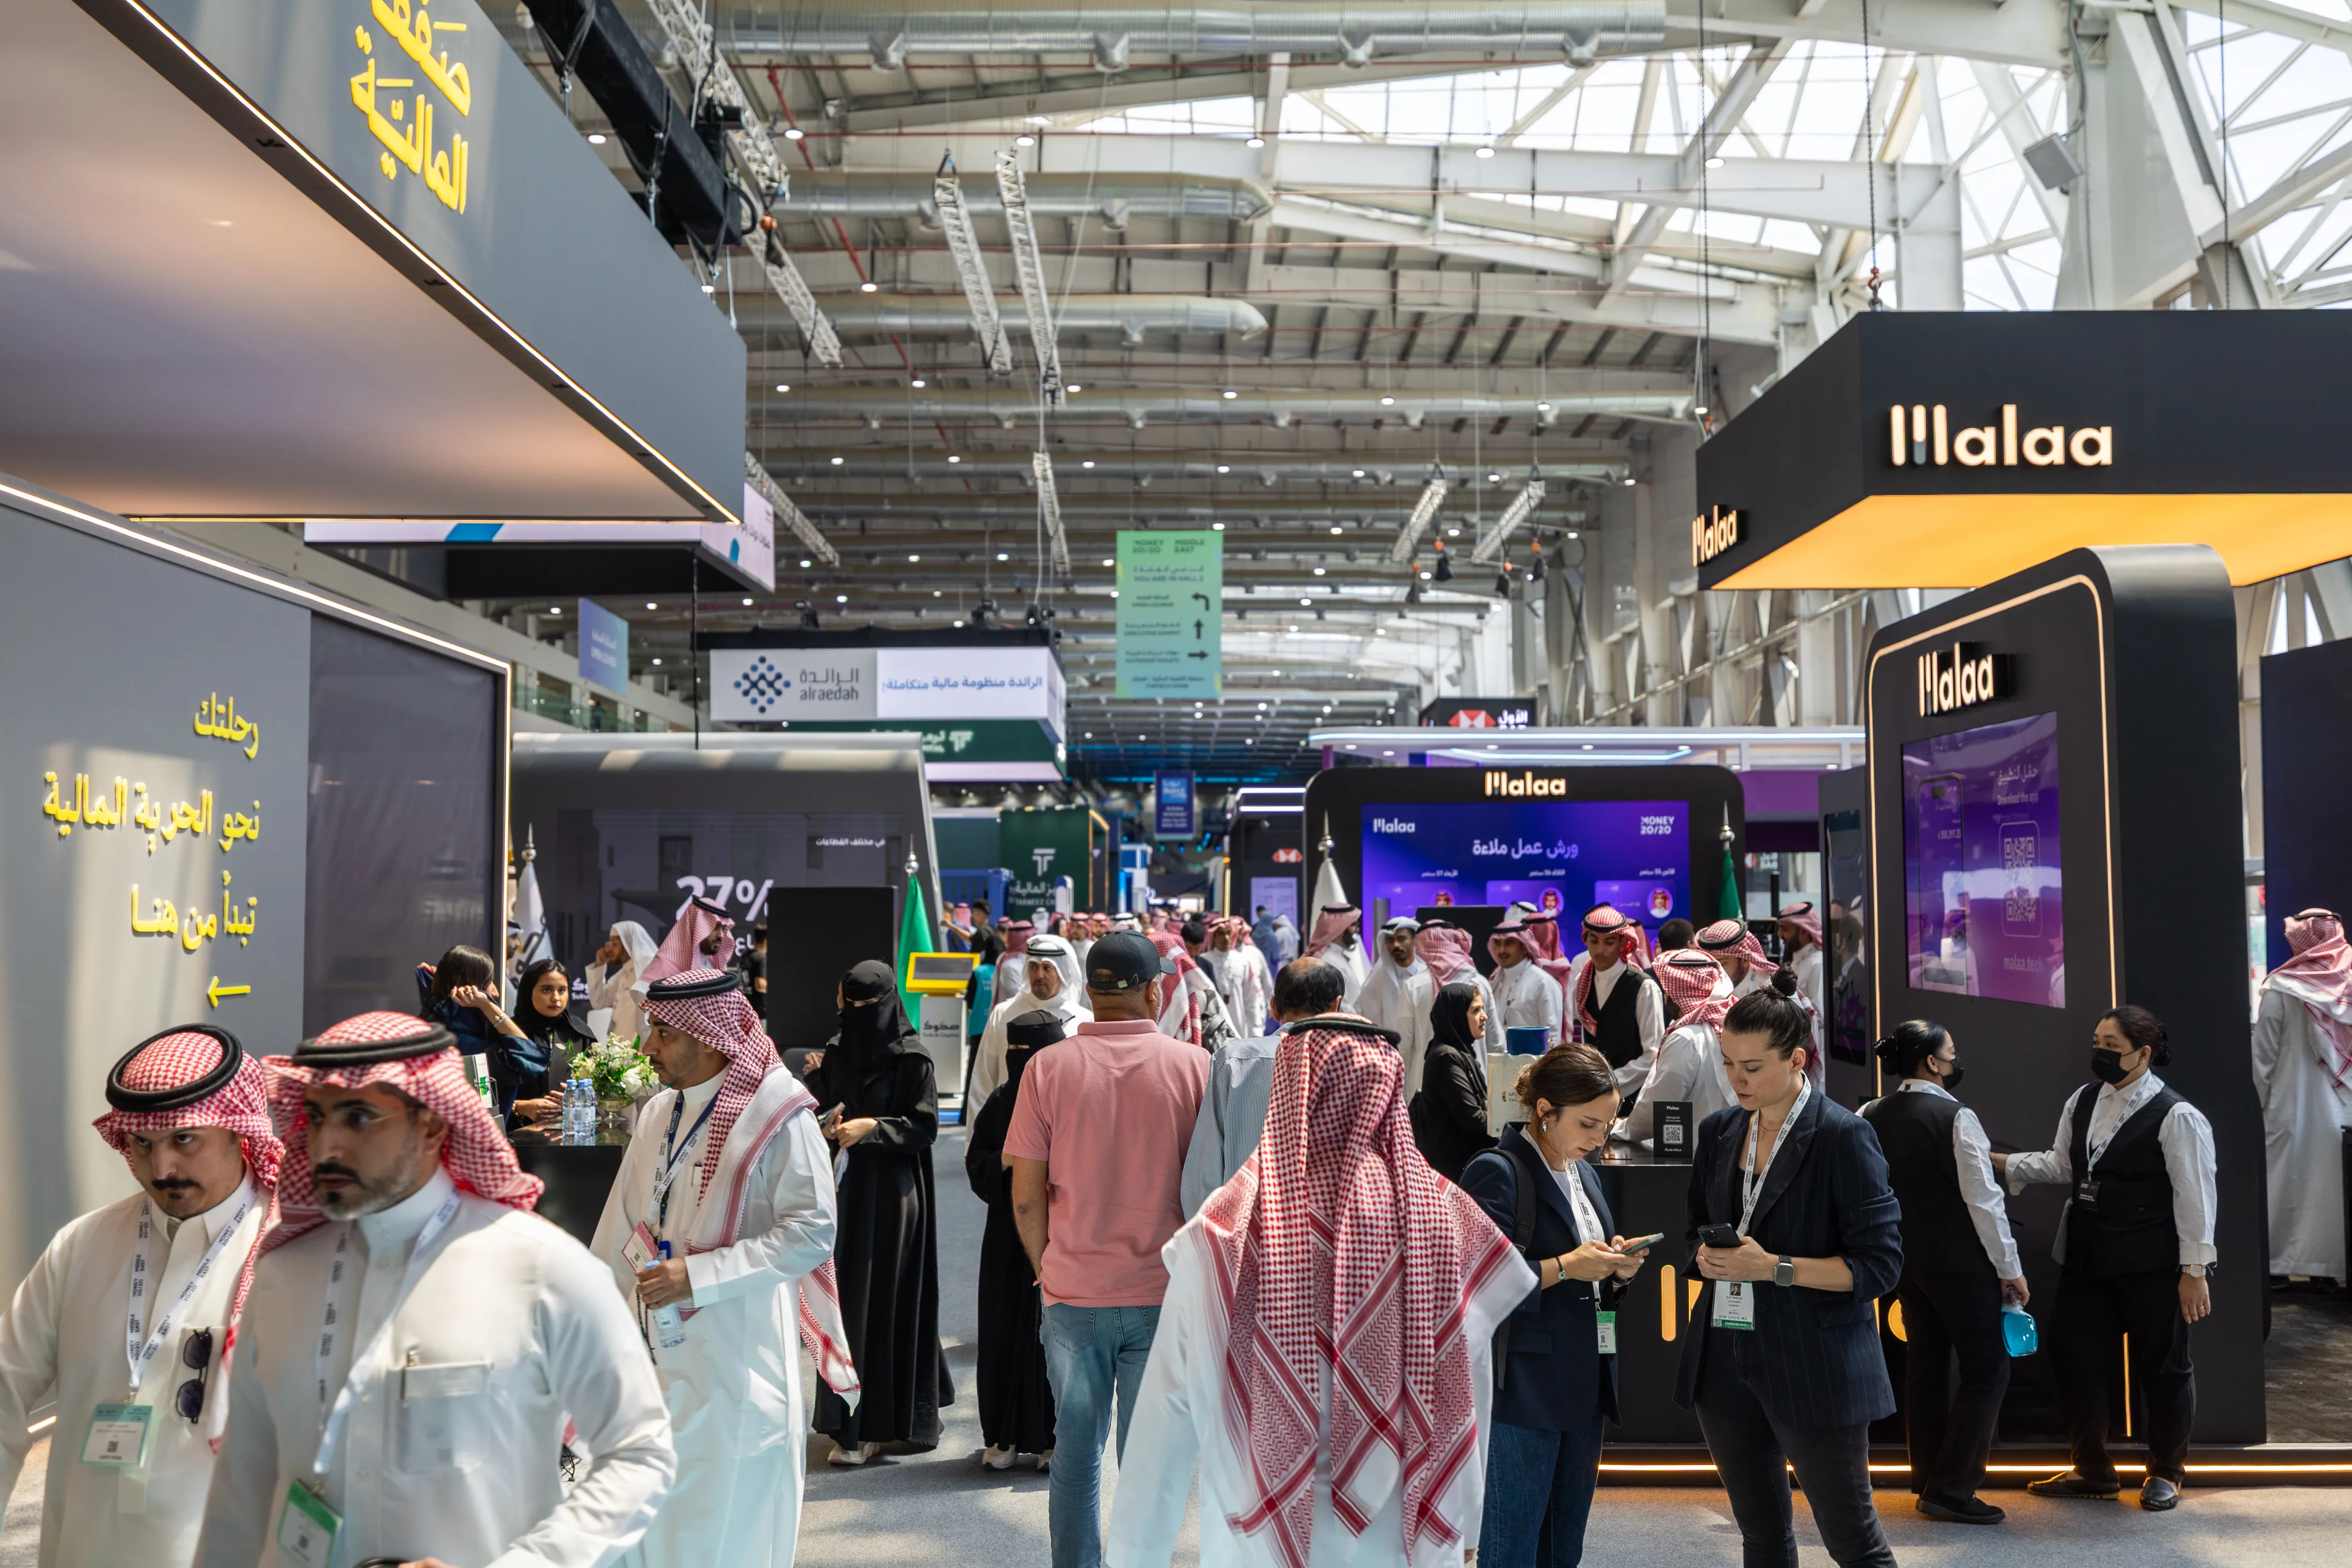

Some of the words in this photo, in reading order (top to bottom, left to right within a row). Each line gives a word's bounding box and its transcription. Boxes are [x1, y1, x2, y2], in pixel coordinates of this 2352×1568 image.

[1890, 404, 2112, 466] Malaa
[1692, 505, 1737, 567] Malaa
[1918, 641, 1994, 717] Malaa
[800, 686, 859, 701] alraedah
[194, 691, 259, 759] رحلتك
[1485, 771, 1566, 797] Malaa
[43, 770, 128, 836] المالية
[1997, 792, 2020, 806] Download
[2029, 792, 2038, 805] app
[218, 799, 260, 852] نحو
[1373, 817, 1416, 834] Malaa
[1641, 815, 1675, 825] MONEY
[1641, 825, 1672, 835] 20/20
[1472, 838, 1508, 856] ملاءة
[1511, 838, 1542, 860] عمل
[1546, 839, 1579, 859] ورش
[131, 883, 178, 933] هنا
[182, 907, 217, 950] من
[2003, 953, 2044, 973] malaa.tech
[924, 1020, 960, 1032] صكوك
[669, 1111, 678, 1134] CONCORD
[1785, 1112, 1794, 1124] MIDDLE
[234, 1203, 246, 1221] MIDDLE
[237, 1211, 246, 1224] EAST
[217, 1225, 232, 1245] MONEY
[196, 1258, 211, 1277] MIDDLE
[200, 1265, 211, 1278] EAST
[162, 1322, 171, 1336] EAST
